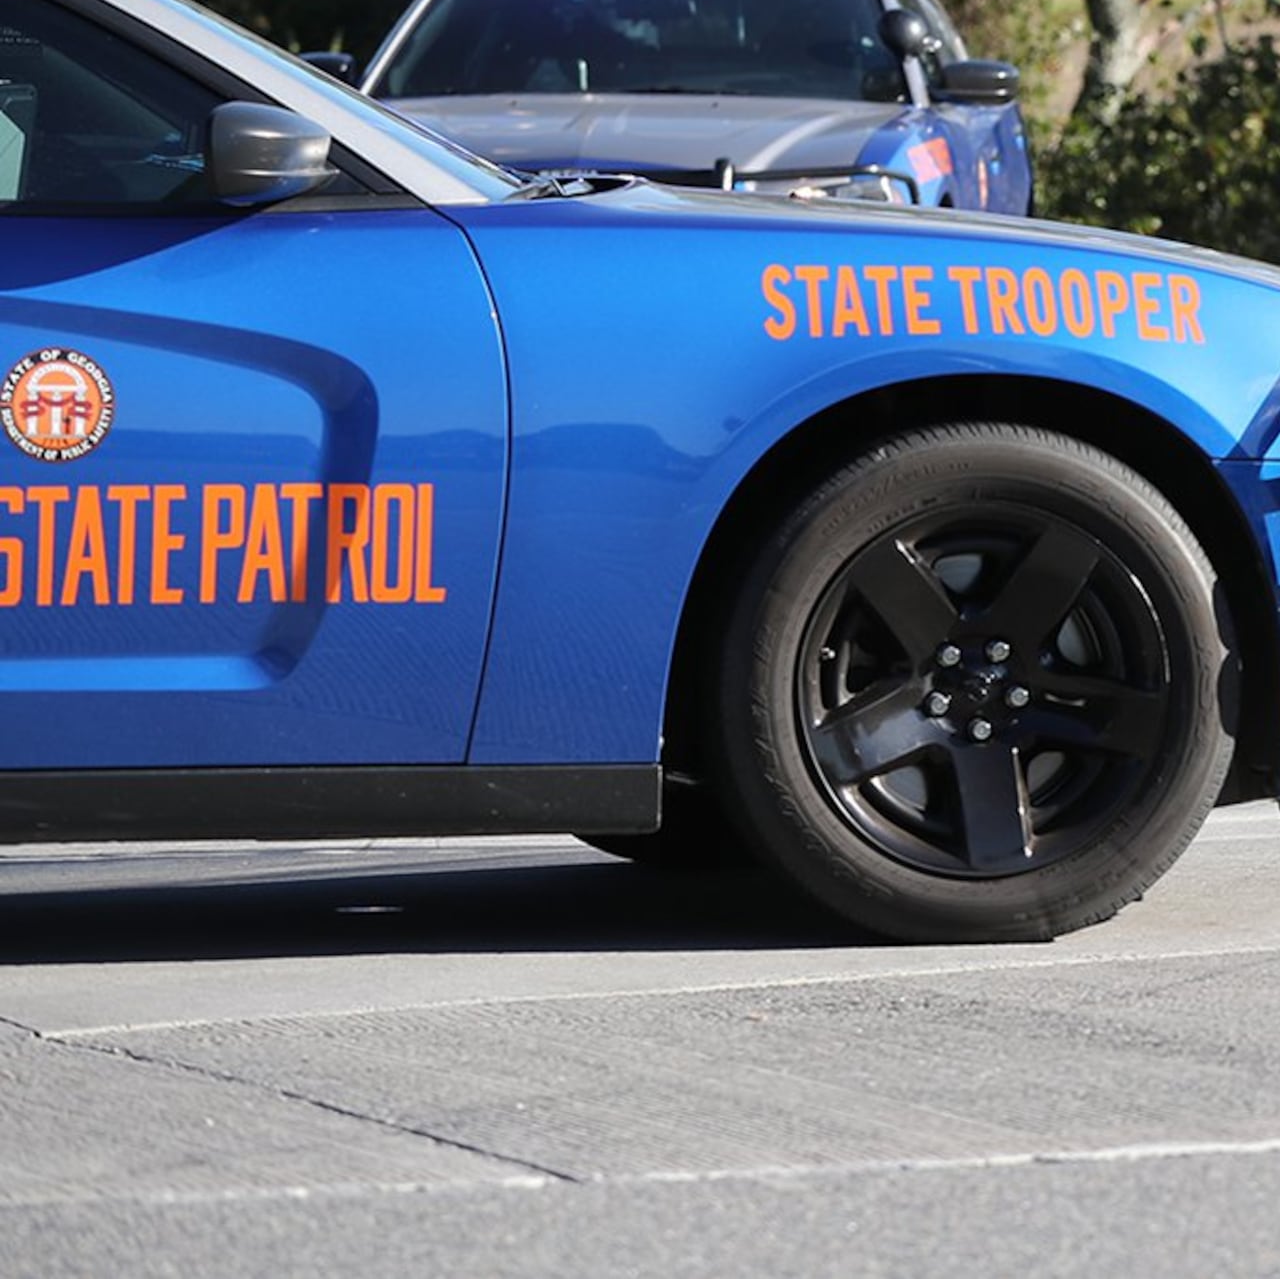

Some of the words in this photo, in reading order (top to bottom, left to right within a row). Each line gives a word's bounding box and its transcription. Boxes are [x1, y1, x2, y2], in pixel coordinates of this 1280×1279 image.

[762, 264, 941, 340] STATE
[947, 266, 1205, 344] TROOPER
[1, 357, 35, 402] STATE
[40, 349, 61, 362] OF
[67, 352, 112, 402] GEORGIA
[0, 485, 187, 606] STATE
[200, 483, 446, 603] PATROL
